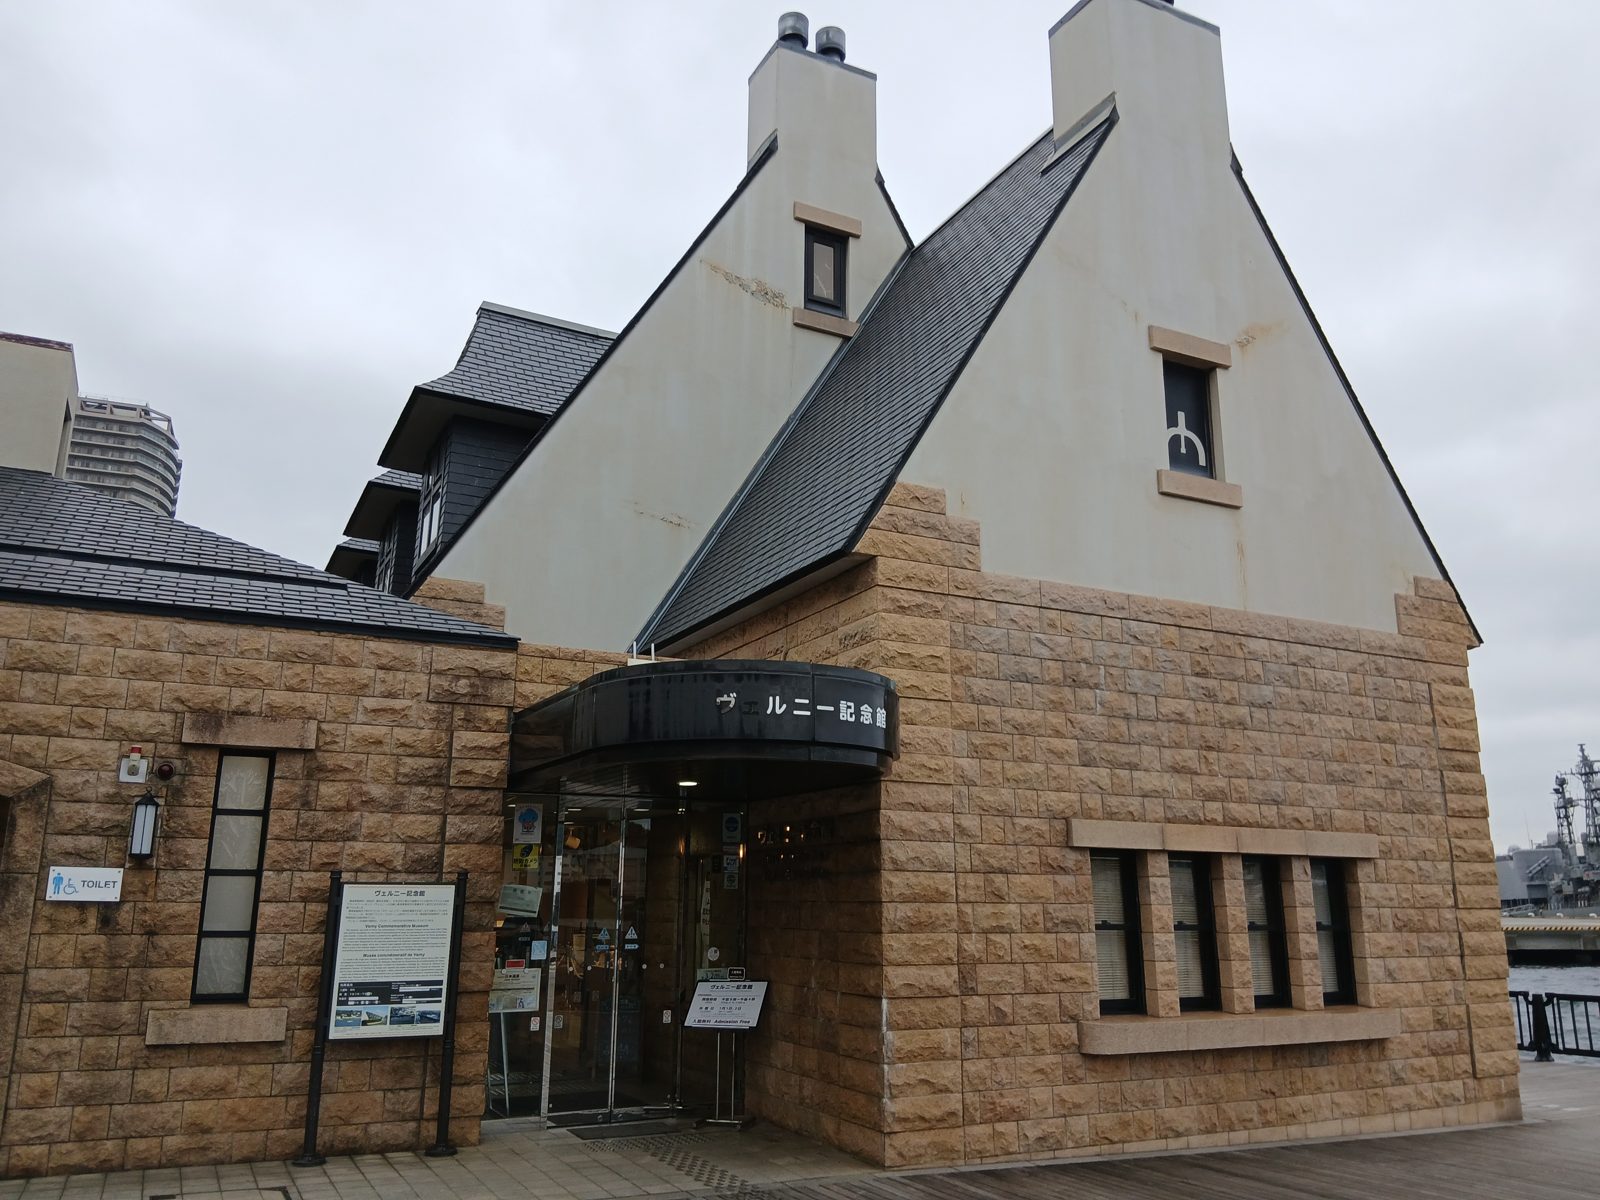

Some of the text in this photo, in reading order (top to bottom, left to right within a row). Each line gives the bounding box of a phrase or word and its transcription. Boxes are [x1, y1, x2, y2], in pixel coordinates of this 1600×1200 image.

[716, 692, 887, 729] ヴェルニー記念館
[81, 880, 118, 889] TOILET
